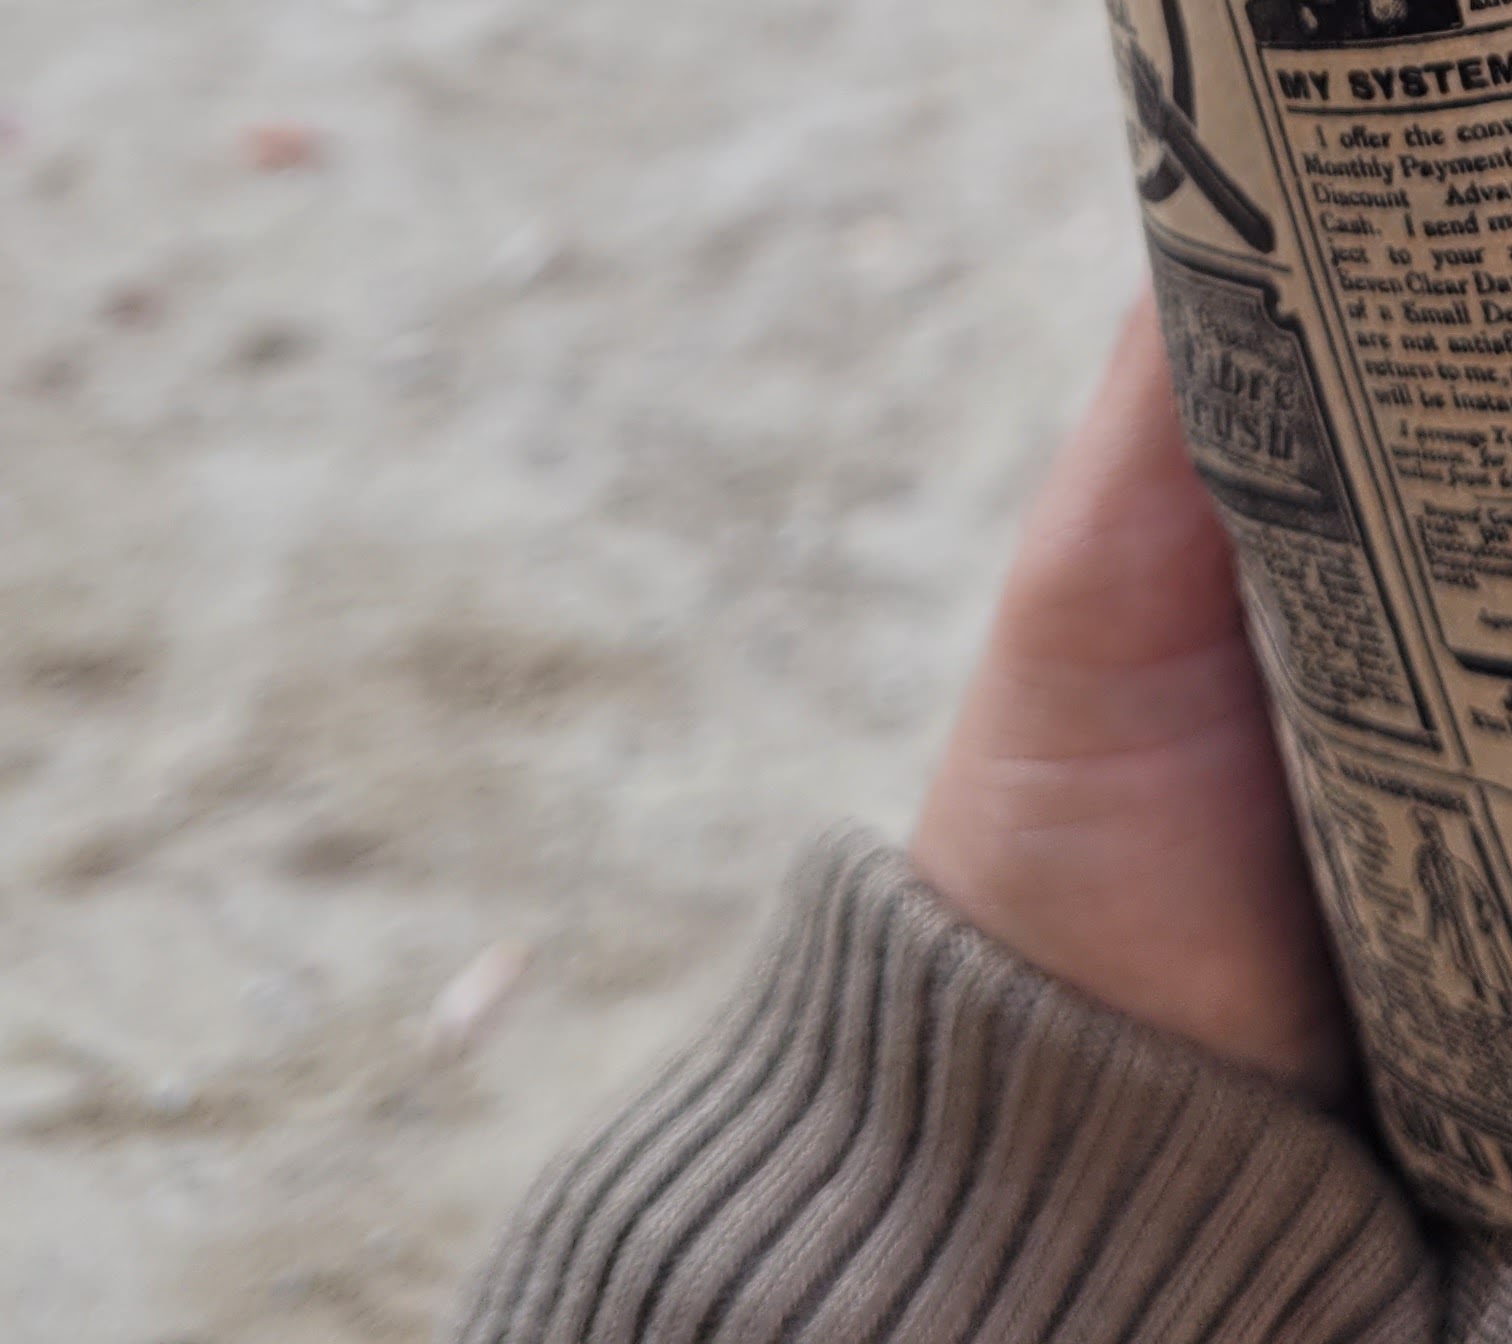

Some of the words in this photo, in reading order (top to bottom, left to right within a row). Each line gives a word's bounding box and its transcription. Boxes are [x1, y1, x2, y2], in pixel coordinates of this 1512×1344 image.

[1276, 68, 1329, 100] MY
[1316, 125, 1328, 148] I
[1340, 125, 1390, 149] offer
[1404, 123, 1445, 147] the
[1302, 153, 1395, 185] Monthly
[1312, 184, 1409, 210] Discount
[1423, 210, 1478, 238] send
[1389, 245, 1411, 264] to
[1433, 246, 1484, 269] your
[1406, 272, 1468, 296] Clear
[1402, 300, 1471, 325] Small
[1357, 330, 1390, 350] are
[1402, 332, 1439, 353] not
[1364, 358, 1433, 381] return
[1437, 362, 1458, 381] to
[1373, 386, 1412, 408] will
[1418, 385, 1445, 409] be
